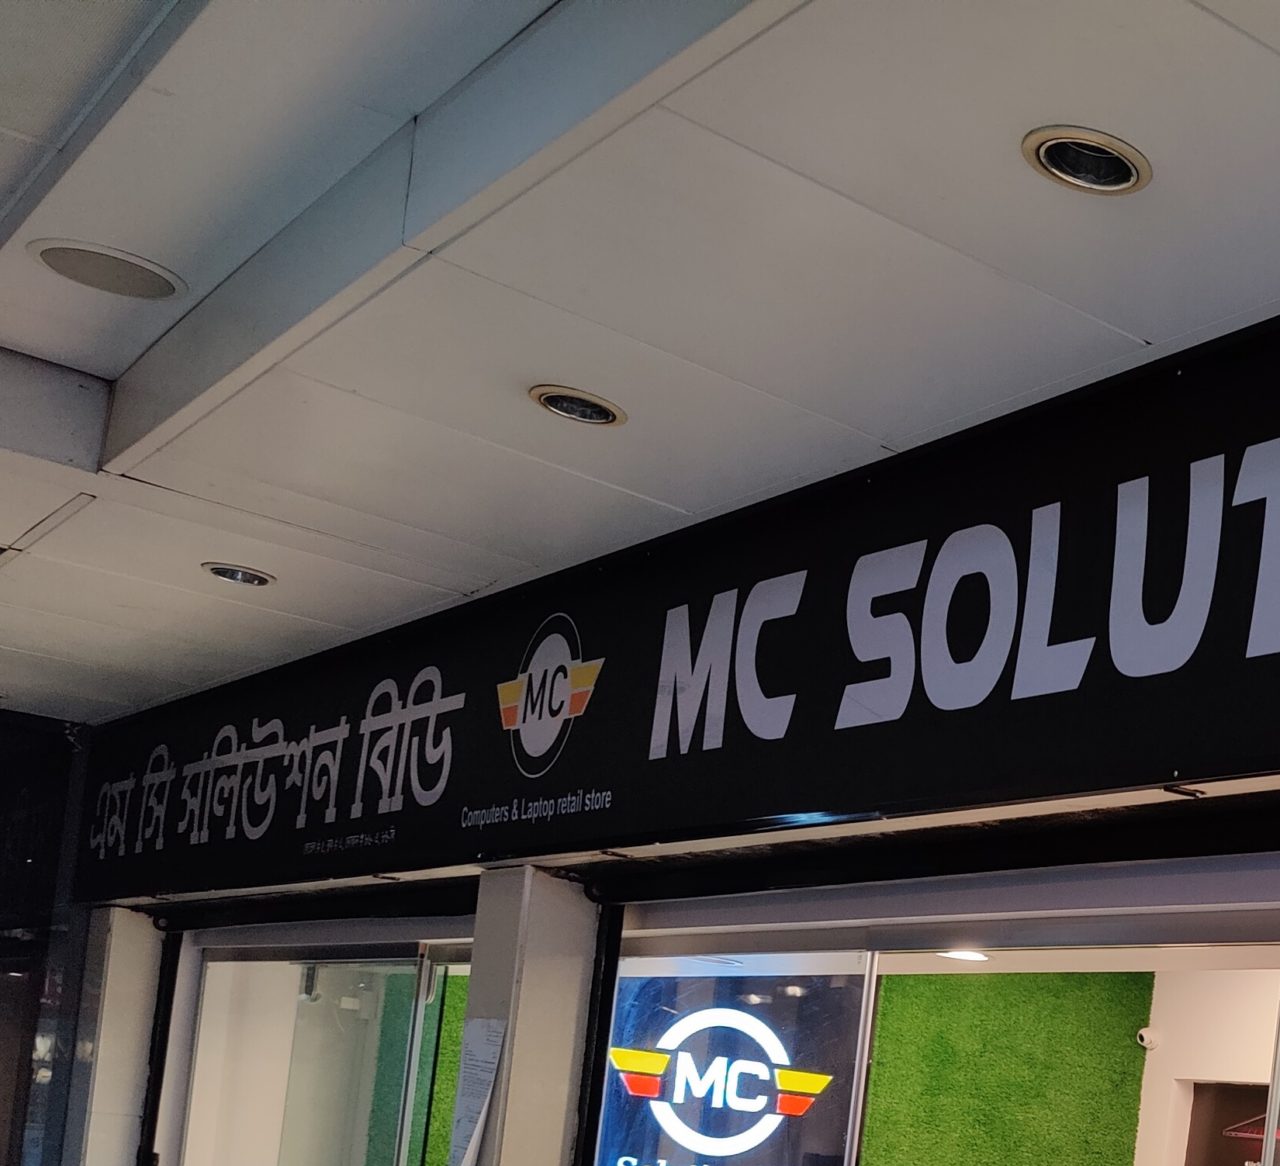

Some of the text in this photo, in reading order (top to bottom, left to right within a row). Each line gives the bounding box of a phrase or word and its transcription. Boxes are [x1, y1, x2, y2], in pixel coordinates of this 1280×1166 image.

[521, 664, 568, 725] MC
[648, 570, 807, 760] MC
[135, 744, 176, 853] সি
[177, 715, 350, 845] সলিউশন
[350, 666, 466, 819] বিডি
[461, 788, 612, 830] Computers & Laptop retail store
[672, 1051, 770, 1113] MC
